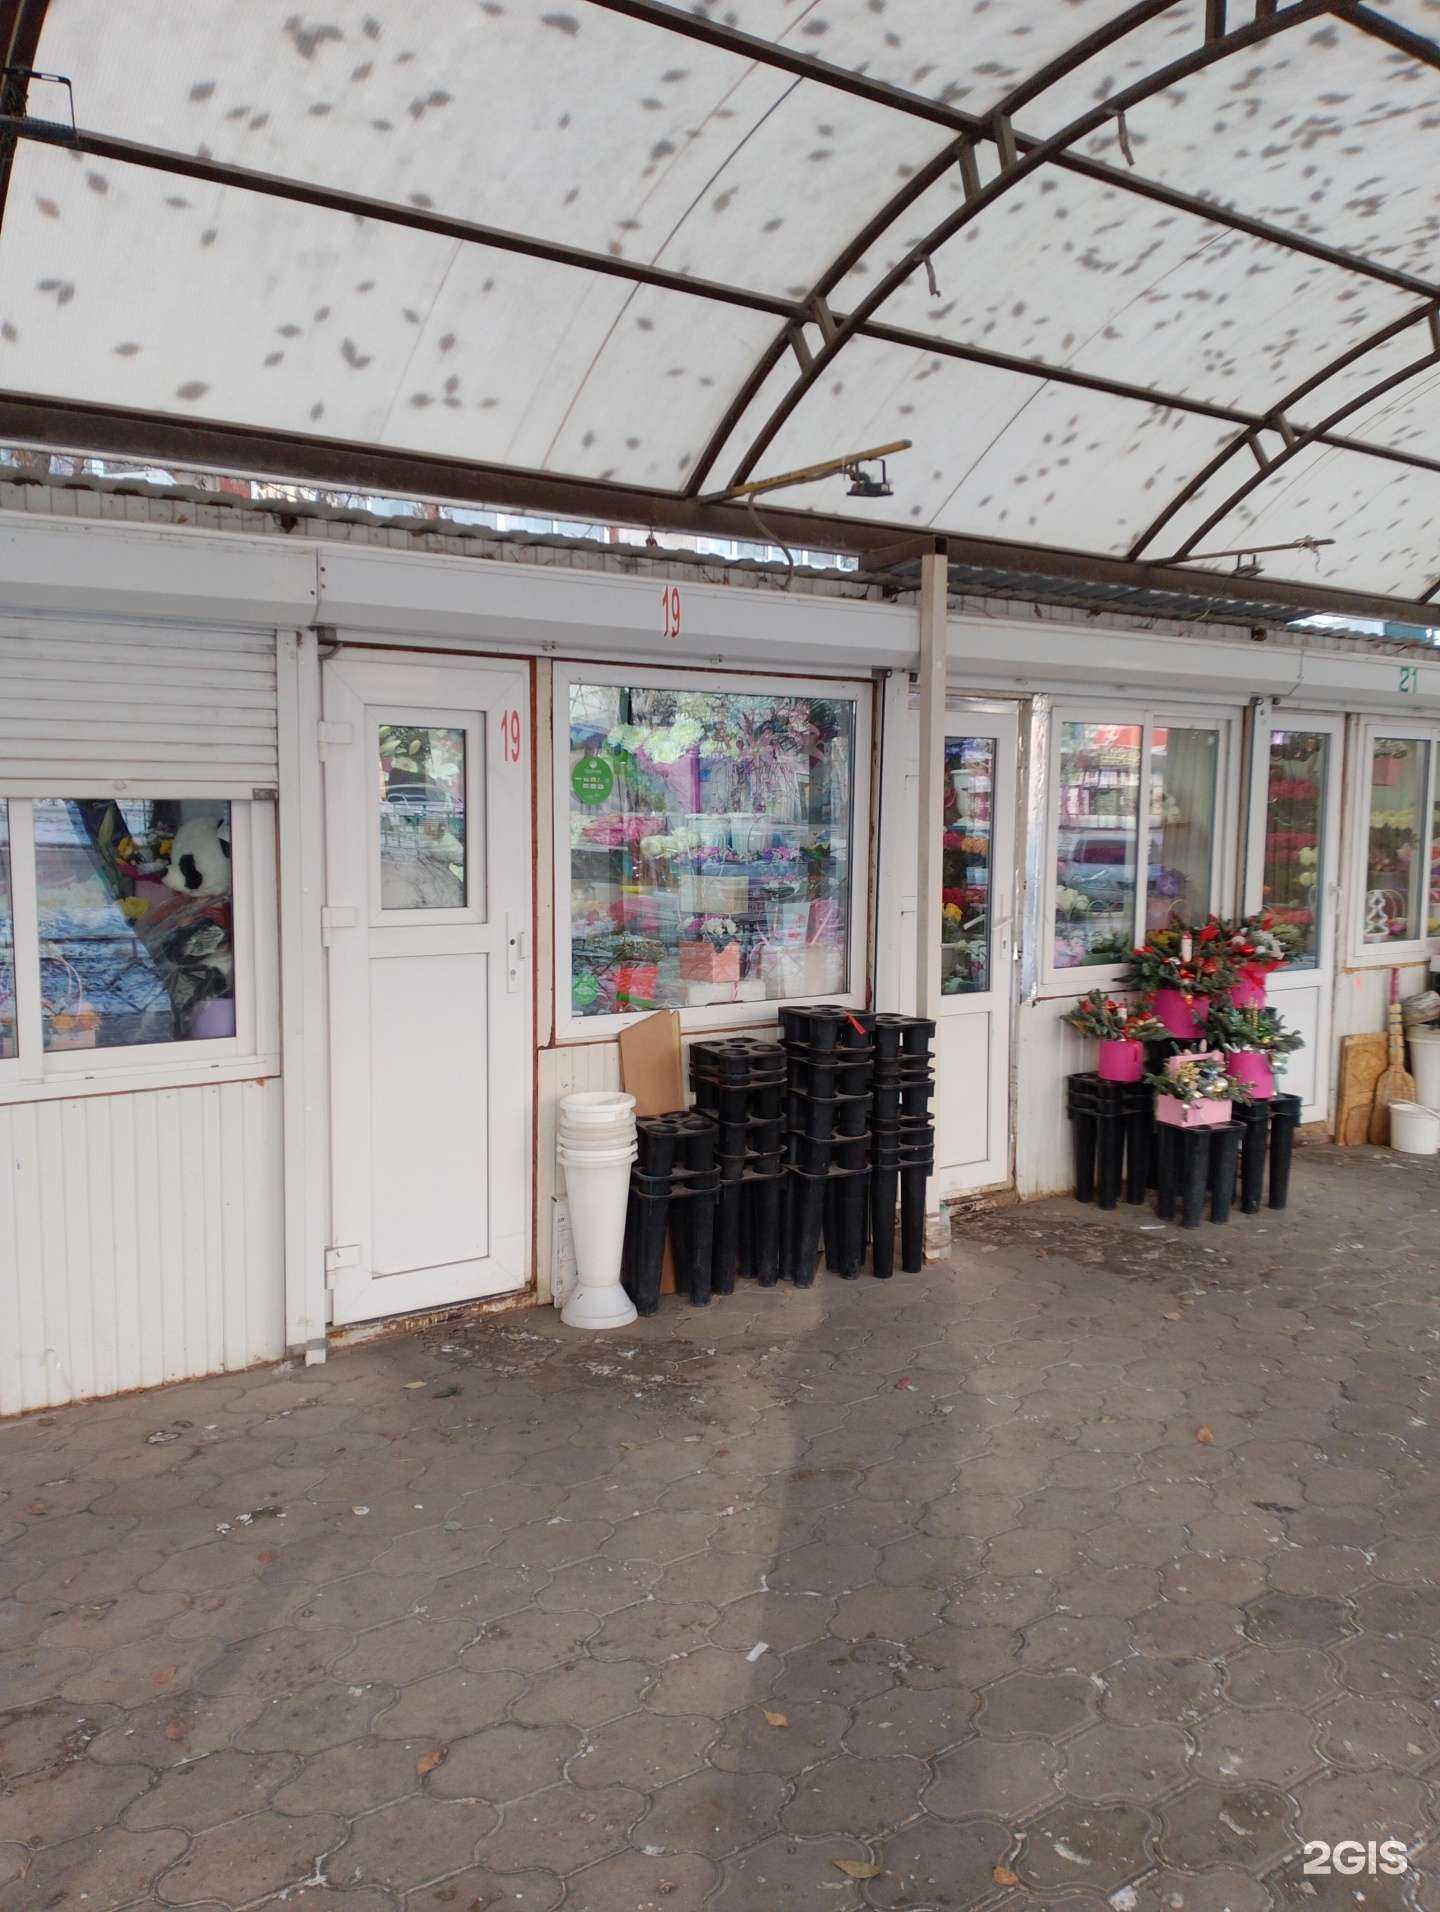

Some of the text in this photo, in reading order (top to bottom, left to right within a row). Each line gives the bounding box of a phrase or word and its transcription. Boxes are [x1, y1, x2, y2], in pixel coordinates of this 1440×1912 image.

[662, 585, 680, 638] 19
[1399, 666, 1417, 694] 21
[500, 710, 520, 762] 19
